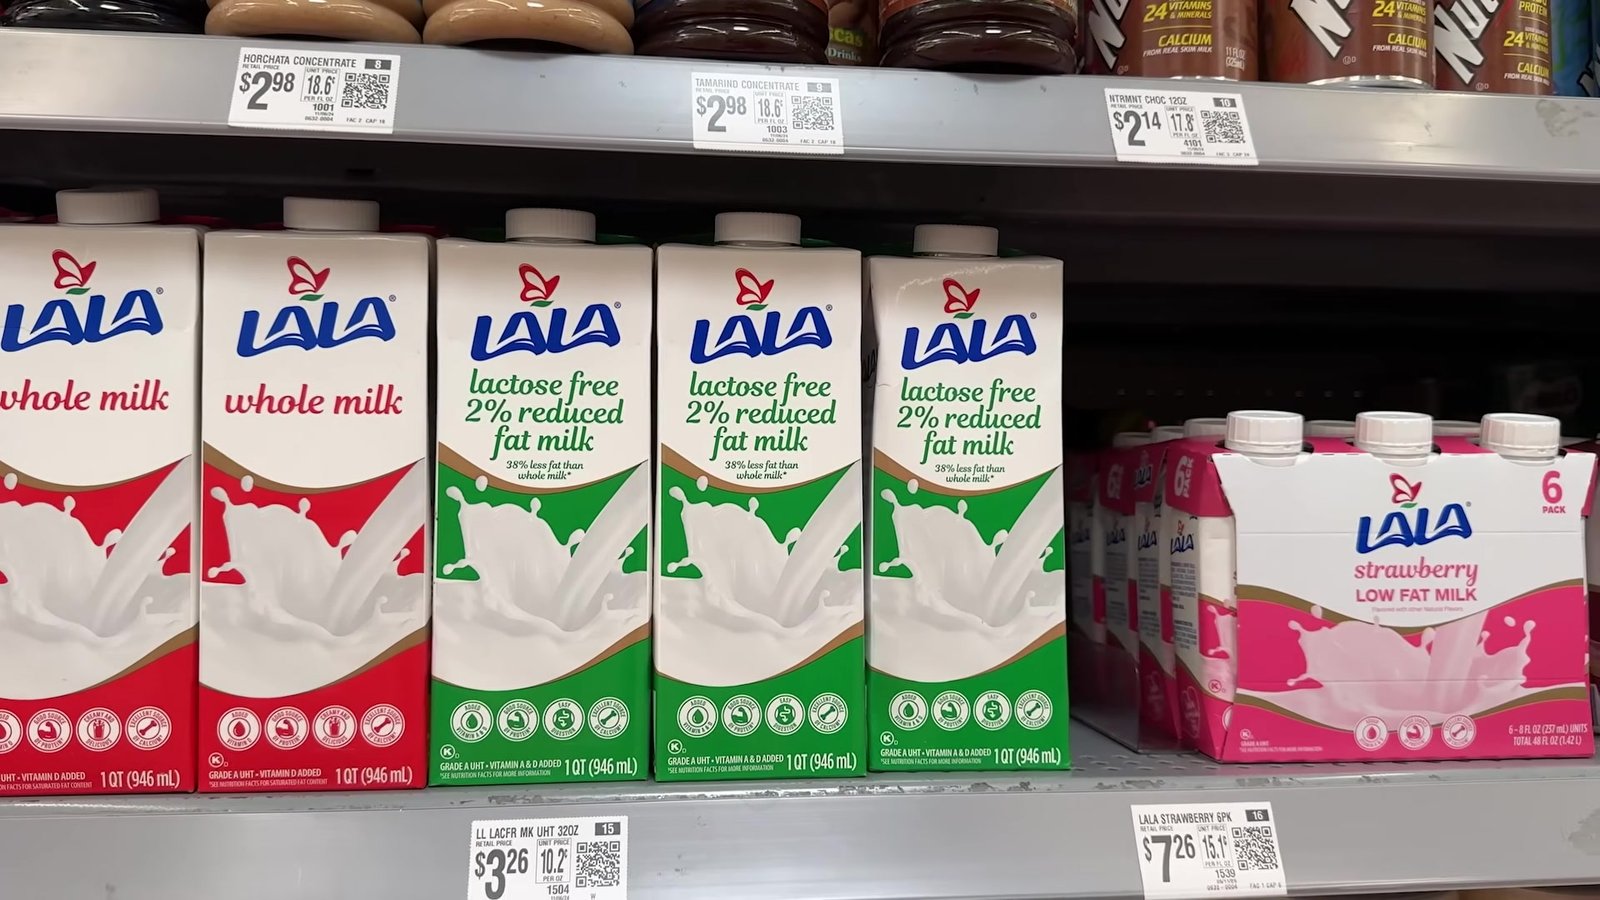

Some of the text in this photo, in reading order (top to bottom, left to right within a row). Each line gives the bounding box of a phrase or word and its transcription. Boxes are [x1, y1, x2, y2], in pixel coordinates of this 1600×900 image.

[1143, 3, 1167, 23] 24
[1168, 2, 1212, 10] VITAMINS
[1372, 1, 1395, 17] 24
[1396, 2, 1426, 16] VITAMINS
[1520, 2, 1548, 16] PROTEIN
[1158, 33, 1212, 47] CALCIUM
[1388, 33, 1426, 50] CALCIUM
[1504, 31, 1524, 47] 24
[244, 54, 357, 67] HORCHATA CONCENTRATE
[1143, 48, 1161, 57] FROM
[375, 60, 381, 68] 8
[1518, 62, 1549, 78] CALCIUM
[696, 79, 799, 91] TAMARIND CONCENTRATE
[816, 84, 822, 92] 9
[1110, 95, 1142, 103] NTRMNT
[1145, 96, 1166, 104] CHOC
[1220, 99, 1231, 107] 10
[1, 289, 163, 352] LALA
[237, 297, 396, 357] LALA
[471, 304, 620, 361] LALA
[690, 307, 832, 364] LALA
[901, 315, 1037, 370] LALA
[100, 379, 169, 410] milk
[470, 368, 619, 406] lactose free
[690, 371, 831, 406] lactose free
[901, 377, 1036, 412] lactose free
[225, 383, 403, 414] whole milk
[465, 398, 624, 424] 2% reduced
[686, 399, 837, 424] 2% reduced
[897, 405, 1041, 429] 2% reduced
[490, 425, 594, 461] fat milk
[710, 426, 808, 461] fat milk
[920, 431, 1014, 464] fat milk
[506, 461, 584, 472] 38% less fat than
[518, 471, 545, 479] whole
[1174, 456, 1189, 496] 6
[1542, 470, 1563, 503] 6
[1542, 506, 1566, 514] PACK
[1356, 503, 1472, 554] LALA
[1138, 531, 1157, 550] LALA
[1170, 534, 1194, 554] LALA
[1354, 557, 1478, 586] strawberry
[1356, 588, 1477, 602] LOW FAT MILK
[1508, 724, 1587, 734] 6 8 FL OZ (237 mL) UNITS
[1514, 736, 1582, 745] TOTAL 48 FL OZ (1.42 L)
[440, 762, 463, 771] GRADE
[465, 762, 470, 770] A
[471, 761, 484, 770] UHT
[489, 761, 518, 769] VITAMIN
[526, 760, 531, 768] &
[533, 760, 537, 768] D
[539, 760, 561, 768] ADDED
[572, 759, 586, 775] QT
[589, 758, 614, 777] (946
[617, 757, 637, 776] mL)
[795, 754, 807, 770] QT
[810, 753, 834, 772] (946
[837, 752, 857, 771] mL)
[109, 771, 123, 787] QT
[127, 770, 154, 789] (946
[157, 770, 180, 788] mL)
[209, 771, 229, 779] GRADE
[240, 770, 254, 778] UHT
[260, 769, 291, 778] VITAMIN
[292, 769, 297, 777] D
[298, 769, 321, 777] ADDED
[344, 768, 358, 783] QT
[362, 767, 387, 785] (946
[390, 766, 412, 784] mL)
[1139, 812, 1232, 825] LALA STRAWBERRY 6PK
[1253, 811, 1263, 820] 16
[476, 828, 486, 839] LL
[490, 828, 517, 839] LACFR
[520, 827, 533, 837] MK
[537, 826, 554, 837] UHT
[602, 824, 614, 834] 15
[1215, 869, 1236, 878] 1539
[547, 885, 569, 894] 1504
